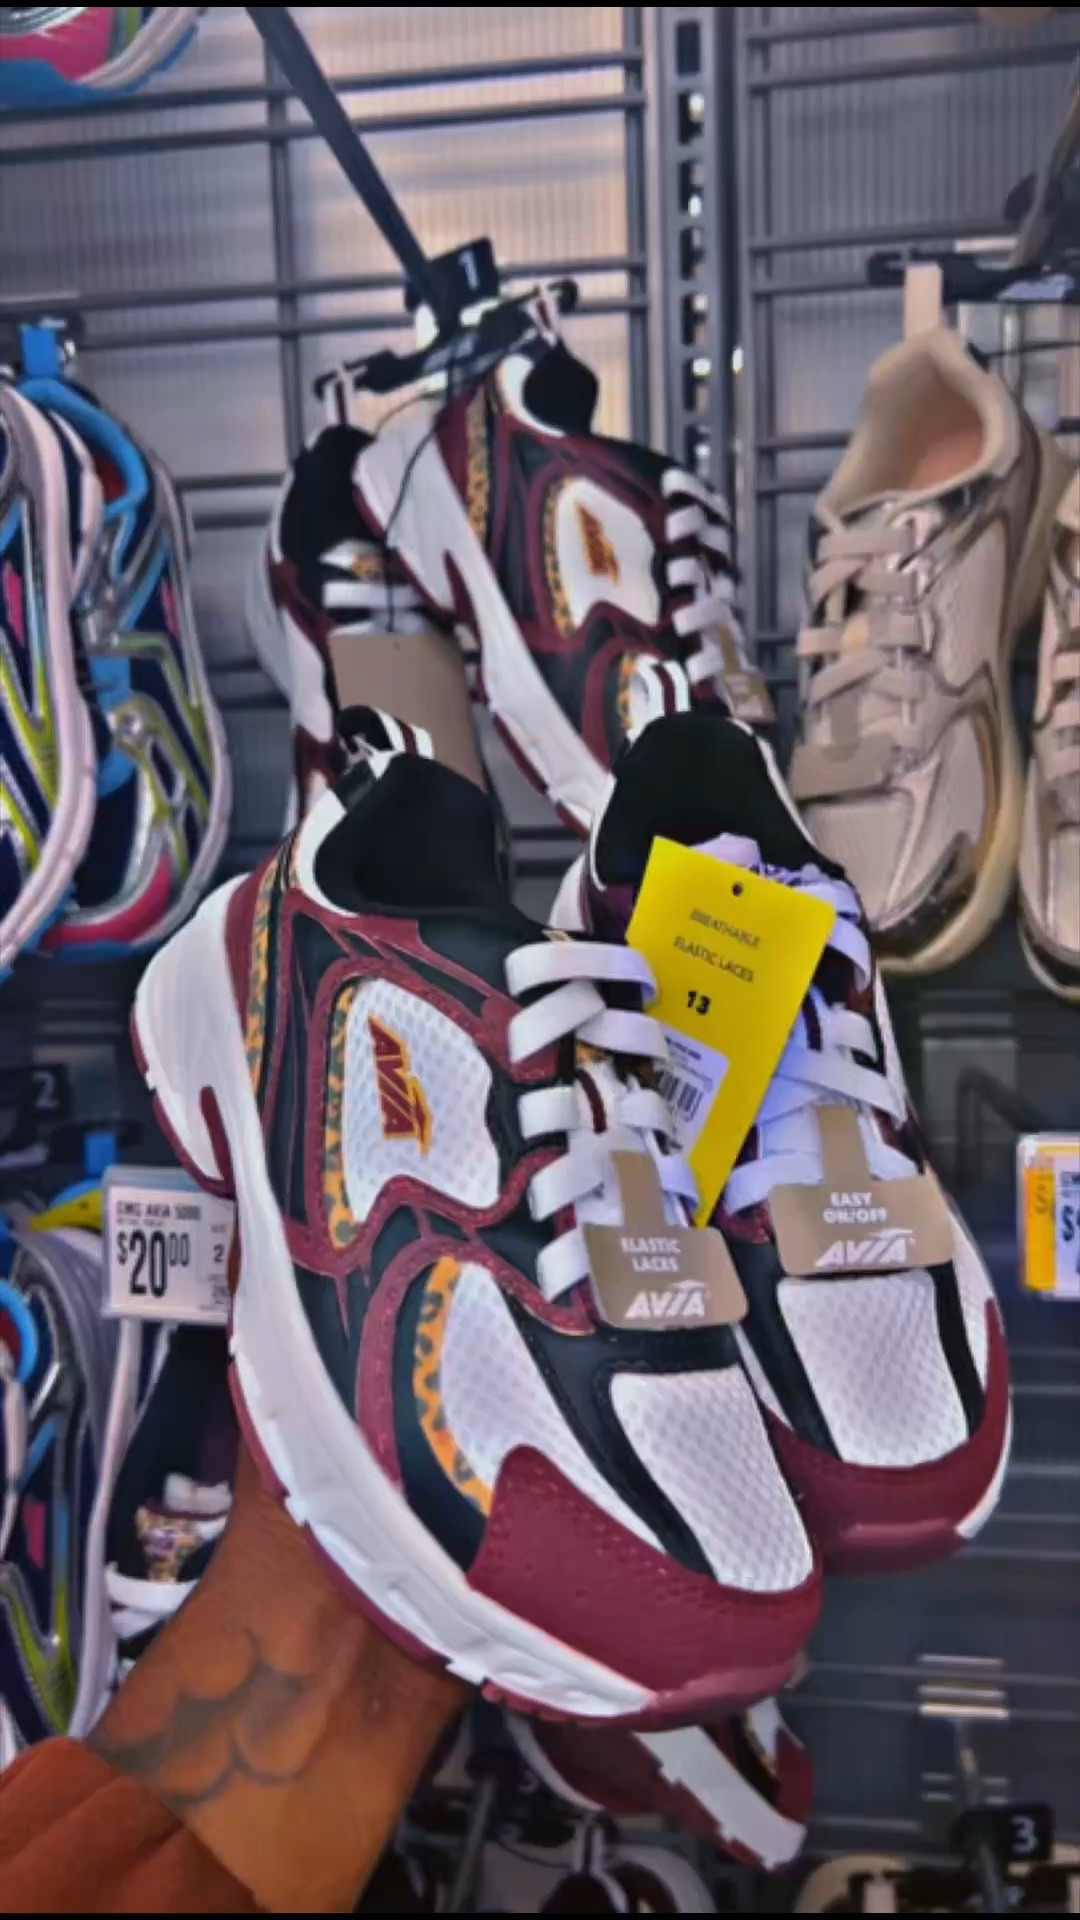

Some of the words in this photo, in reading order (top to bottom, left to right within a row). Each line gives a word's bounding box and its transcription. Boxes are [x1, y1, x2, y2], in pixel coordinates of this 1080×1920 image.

[458, 250, 478, 289] 1
[718, 956, 754, 983] LACES
[686, 990, 711, 1016] 13
[367, 1015, 434, 1155] AVIA
[830, 1192, 872, 1206] EASY
[823, 1207, 888, 1223] ON/OFF
[620, 1237, 681, 1254] ELASTIC
[815, 1227, 915, 1267] AVIA
[631, 1255, 680, 1273] LACES
[625, 1279, 708, 1318] AVIA
[1010, 1815, 1037, 1855] 3
